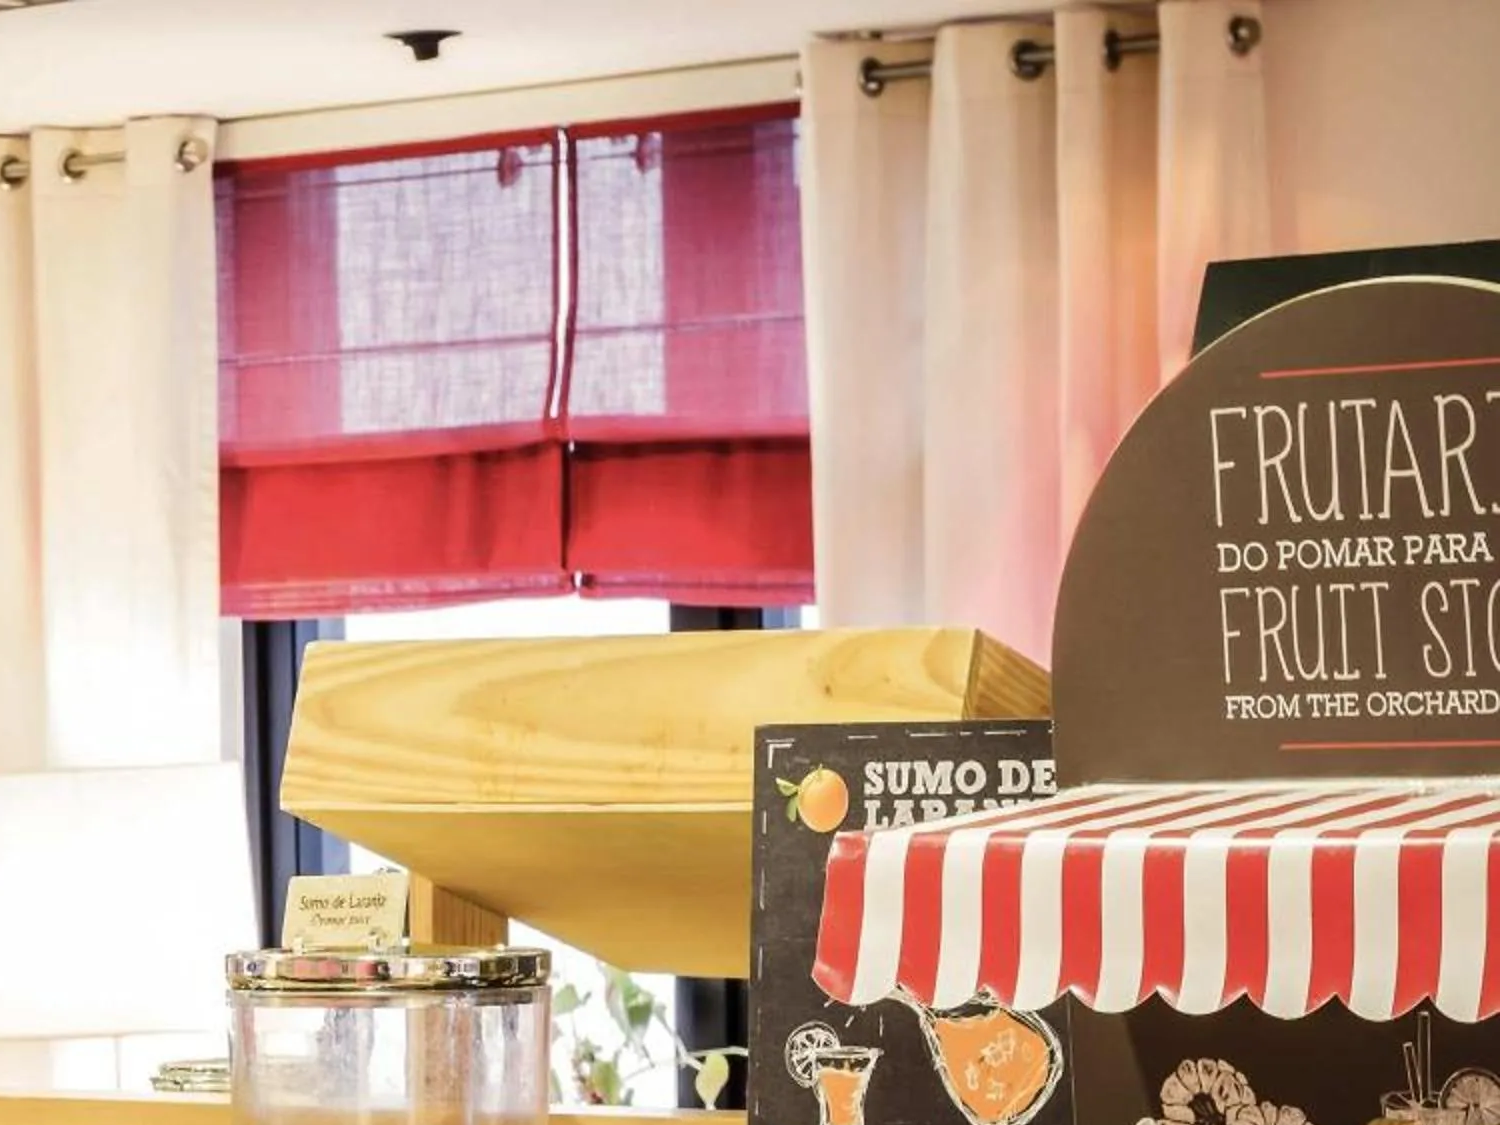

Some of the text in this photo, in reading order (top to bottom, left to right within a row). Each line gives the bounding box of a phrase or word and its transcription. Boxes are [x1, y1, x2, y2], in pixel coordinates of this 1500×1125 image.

[1216, 531, 1495, 573] DO POMAR PARA
[1219, 581, 1390, 685] FRUIT
[1225, 690, 1500, 719] FROM THE ORCHARD
[863, 759, 1058, 796] SUMO DE
